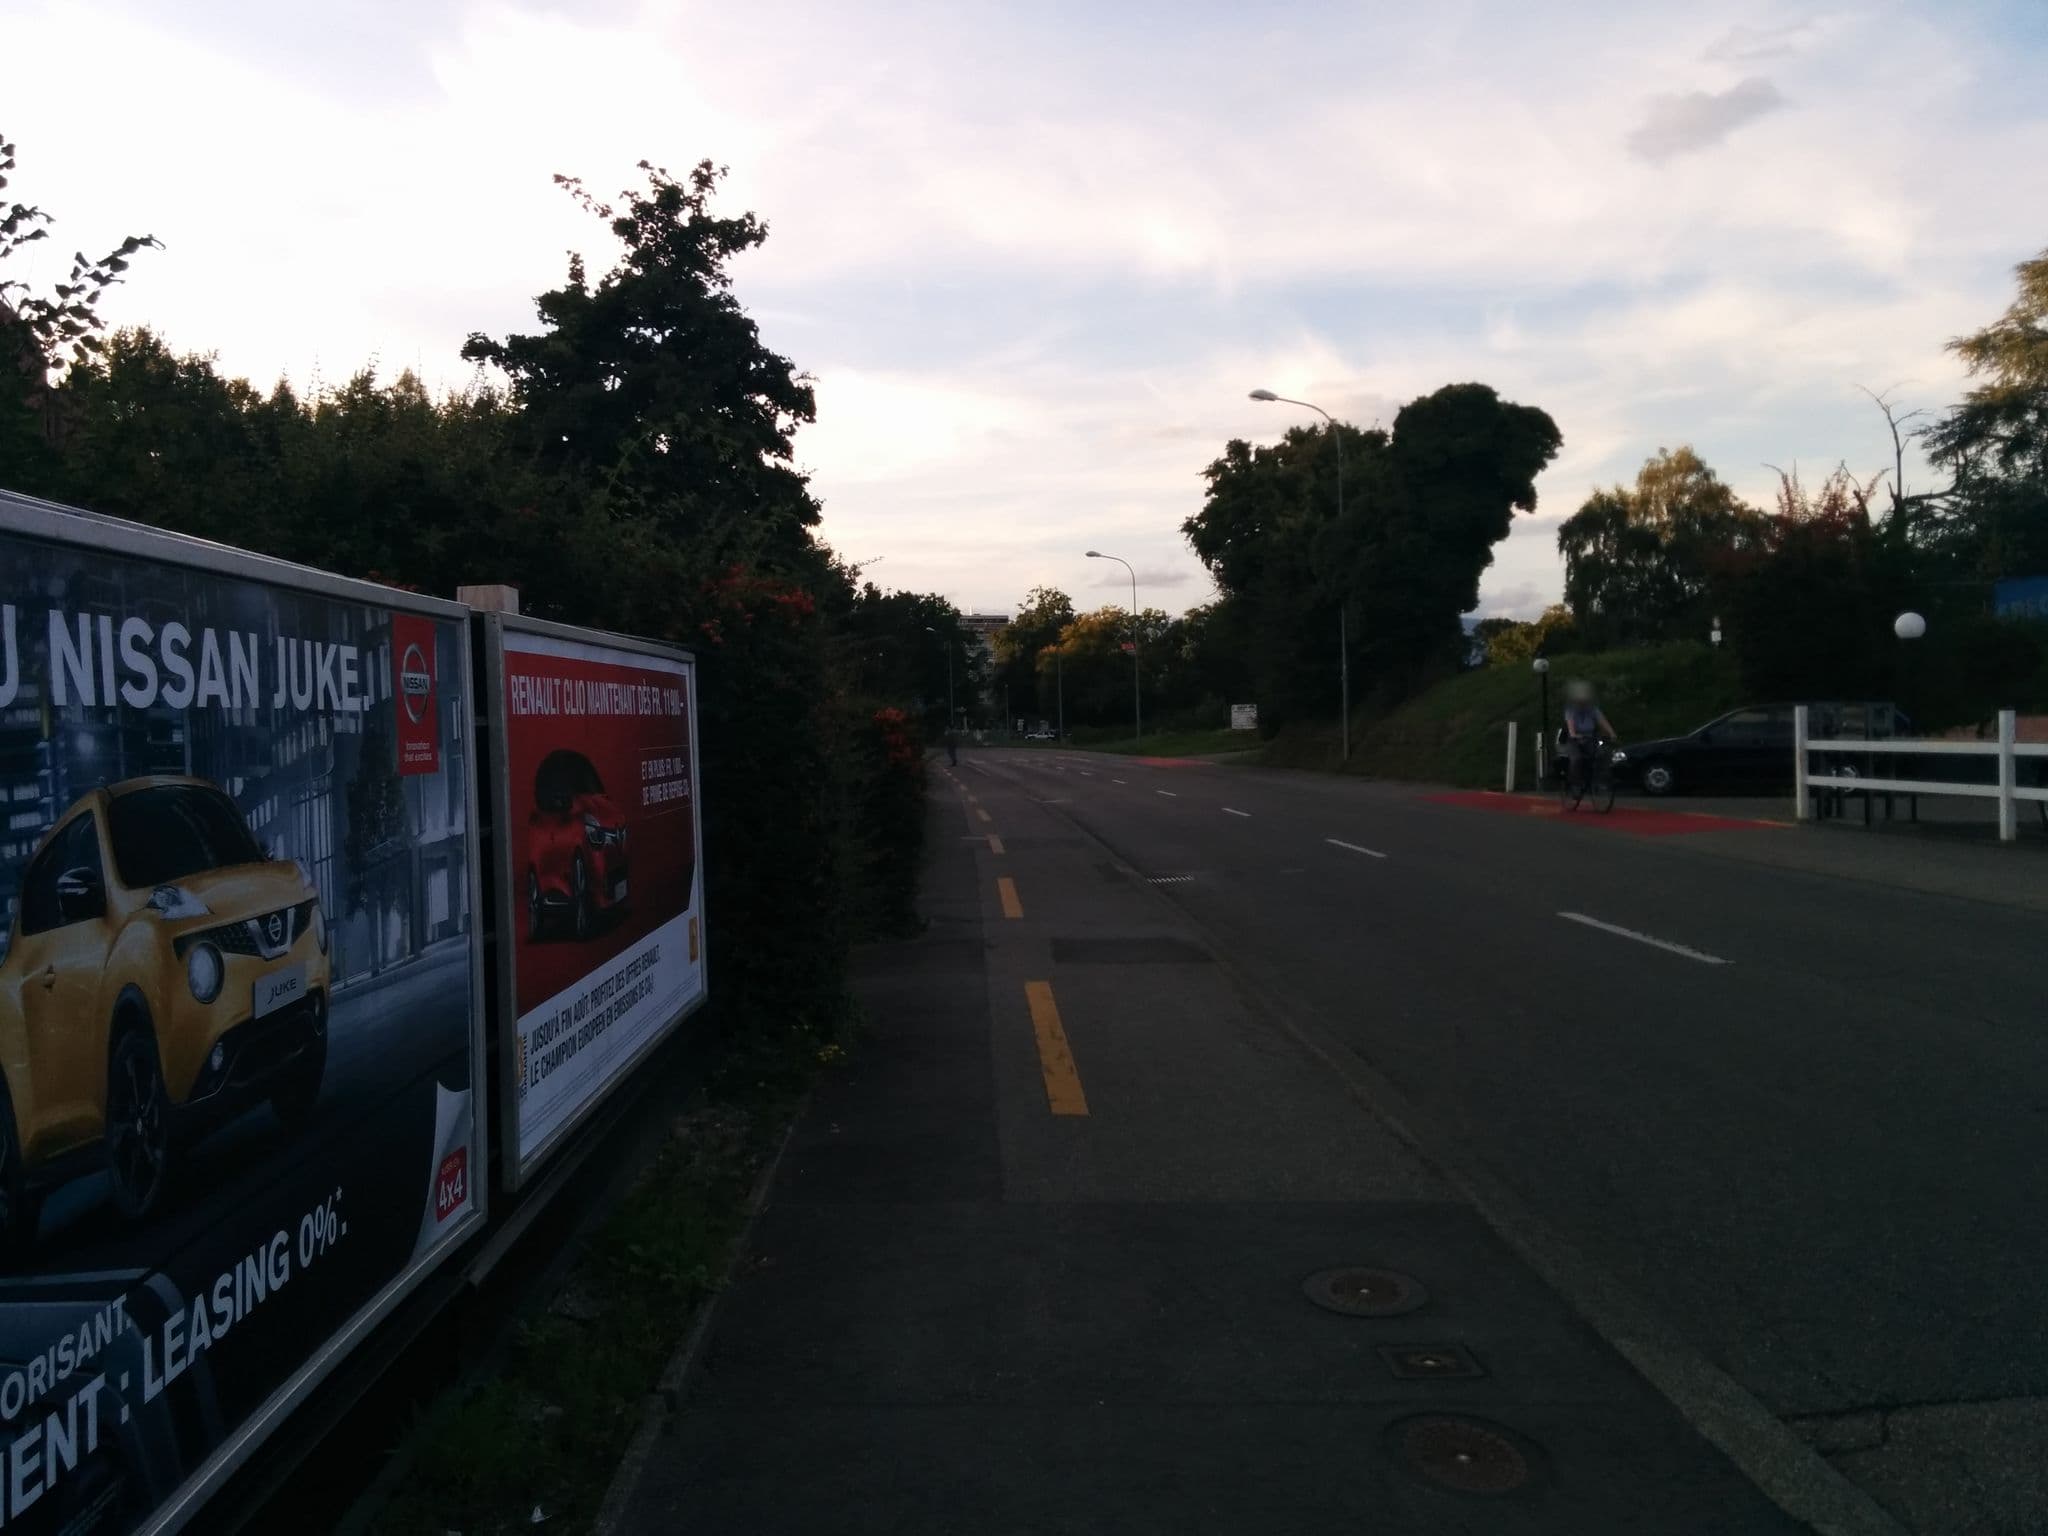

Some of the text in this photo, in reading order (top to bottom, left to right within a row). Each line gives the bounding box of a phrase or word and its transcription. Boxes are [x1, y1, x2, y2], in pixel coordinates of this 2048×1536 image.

[49, 609, 260, 709] NISSAN
[511, 675, 560, 715] RENAULT
[563, 679, 585, 715] CLIO
[587, 681, 635, 715] MAINTENANT
[267, 978, 297, 1004] JUKE
[530, 1060, 540, 1088] LE
[439, 1168, 463, 1211] 4x4
[0, 1372, 106, 1530] ENT
[143, 1229, 290, 1404] LEASING
